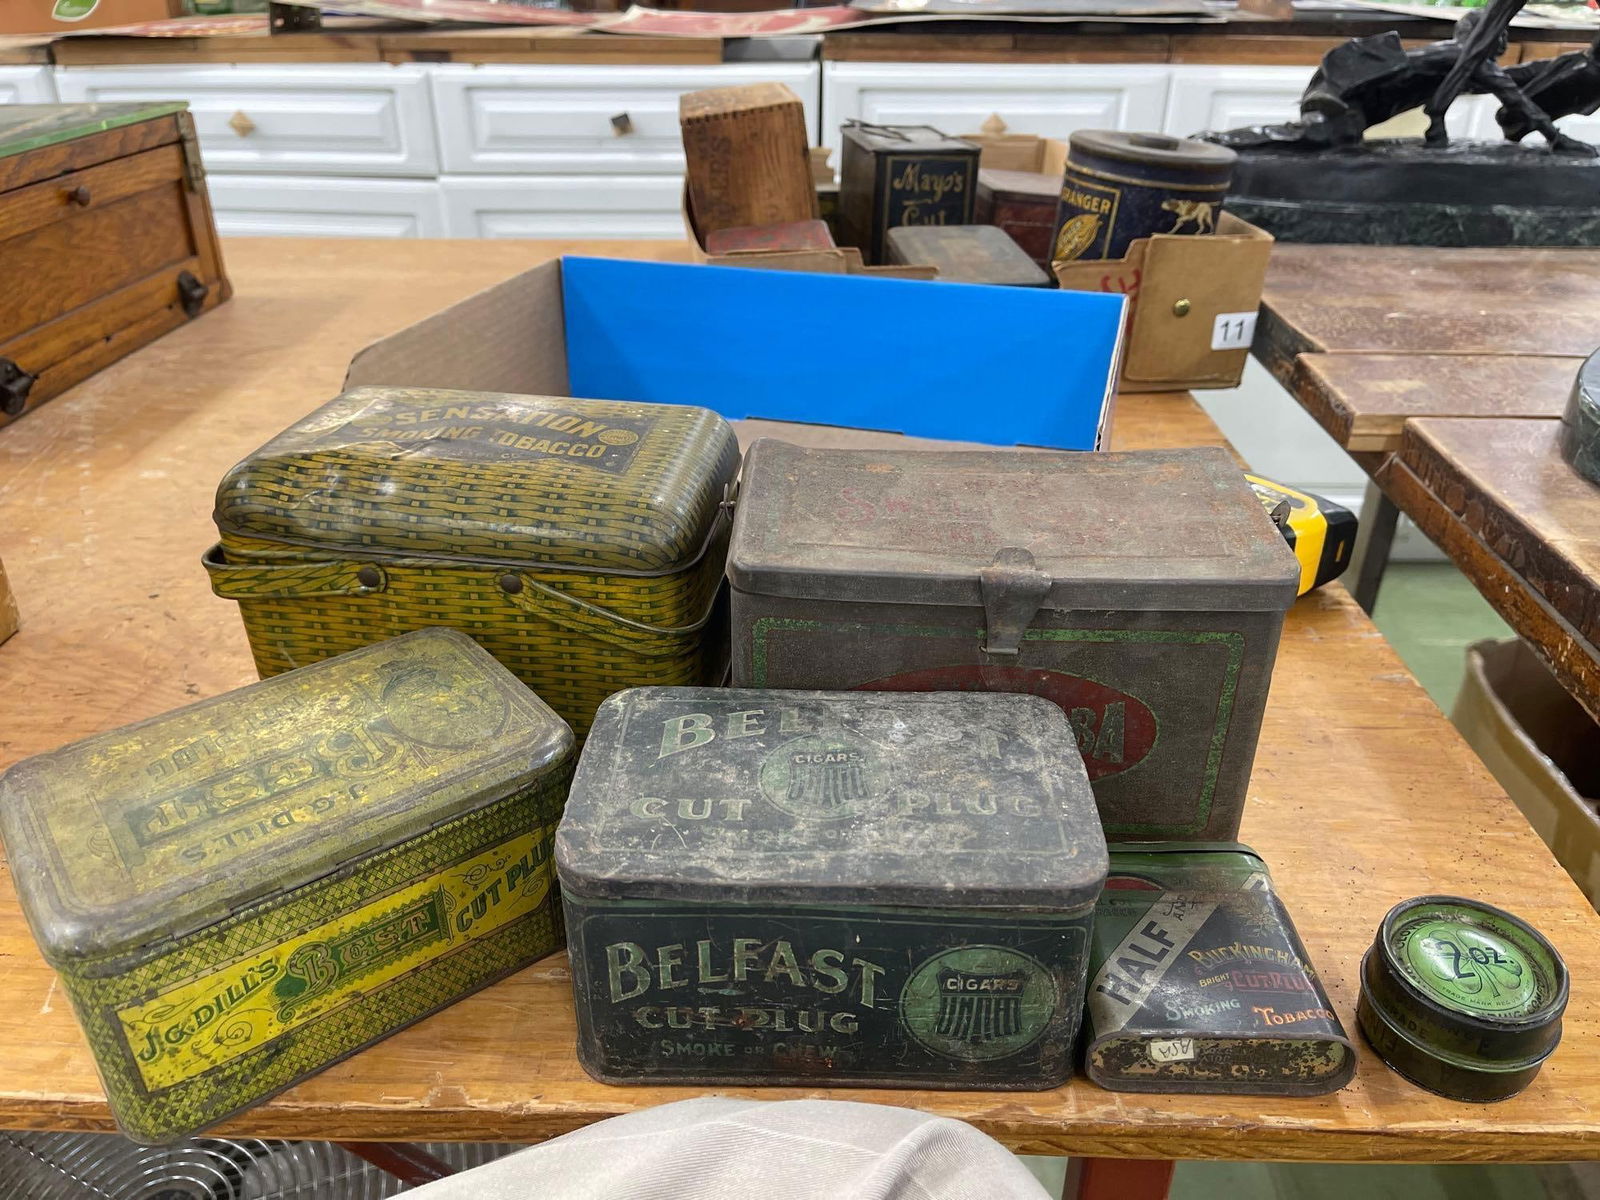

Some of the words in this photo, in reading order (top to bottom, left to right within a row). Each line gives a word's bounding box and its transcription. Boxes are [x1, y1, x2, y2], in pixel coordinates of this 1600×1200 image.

[893, 163, 963, 203] Mayo's
[1061, 186, 1112, 214] RANGER
[1220, 320, 1244, 342] 11
[629, 797, 752, 821] CUT
[897, 793, 1042, 818] PLUG
[455, 883, 503, 933] CUT
[506, 838, 552, 892] PLU
[604, 938, 887, 1009] BELFAST
[1096, 920, 1176, 1006] HALF
[1434, 940, 1476, 979] 2
[945, 976, 1019, 991] CIGARS
[1199, 972, 1231, 988] BRIGHT
[633, 1006, 721, 1030] CUT
[732, 1007, 859, 1034] PLUG
[1163, 998, 1242, 1022] SMOKING
[1251, 1006, 1336, 1026] TOBACCO
[659, 1039, 736, 1057] SMOKE
